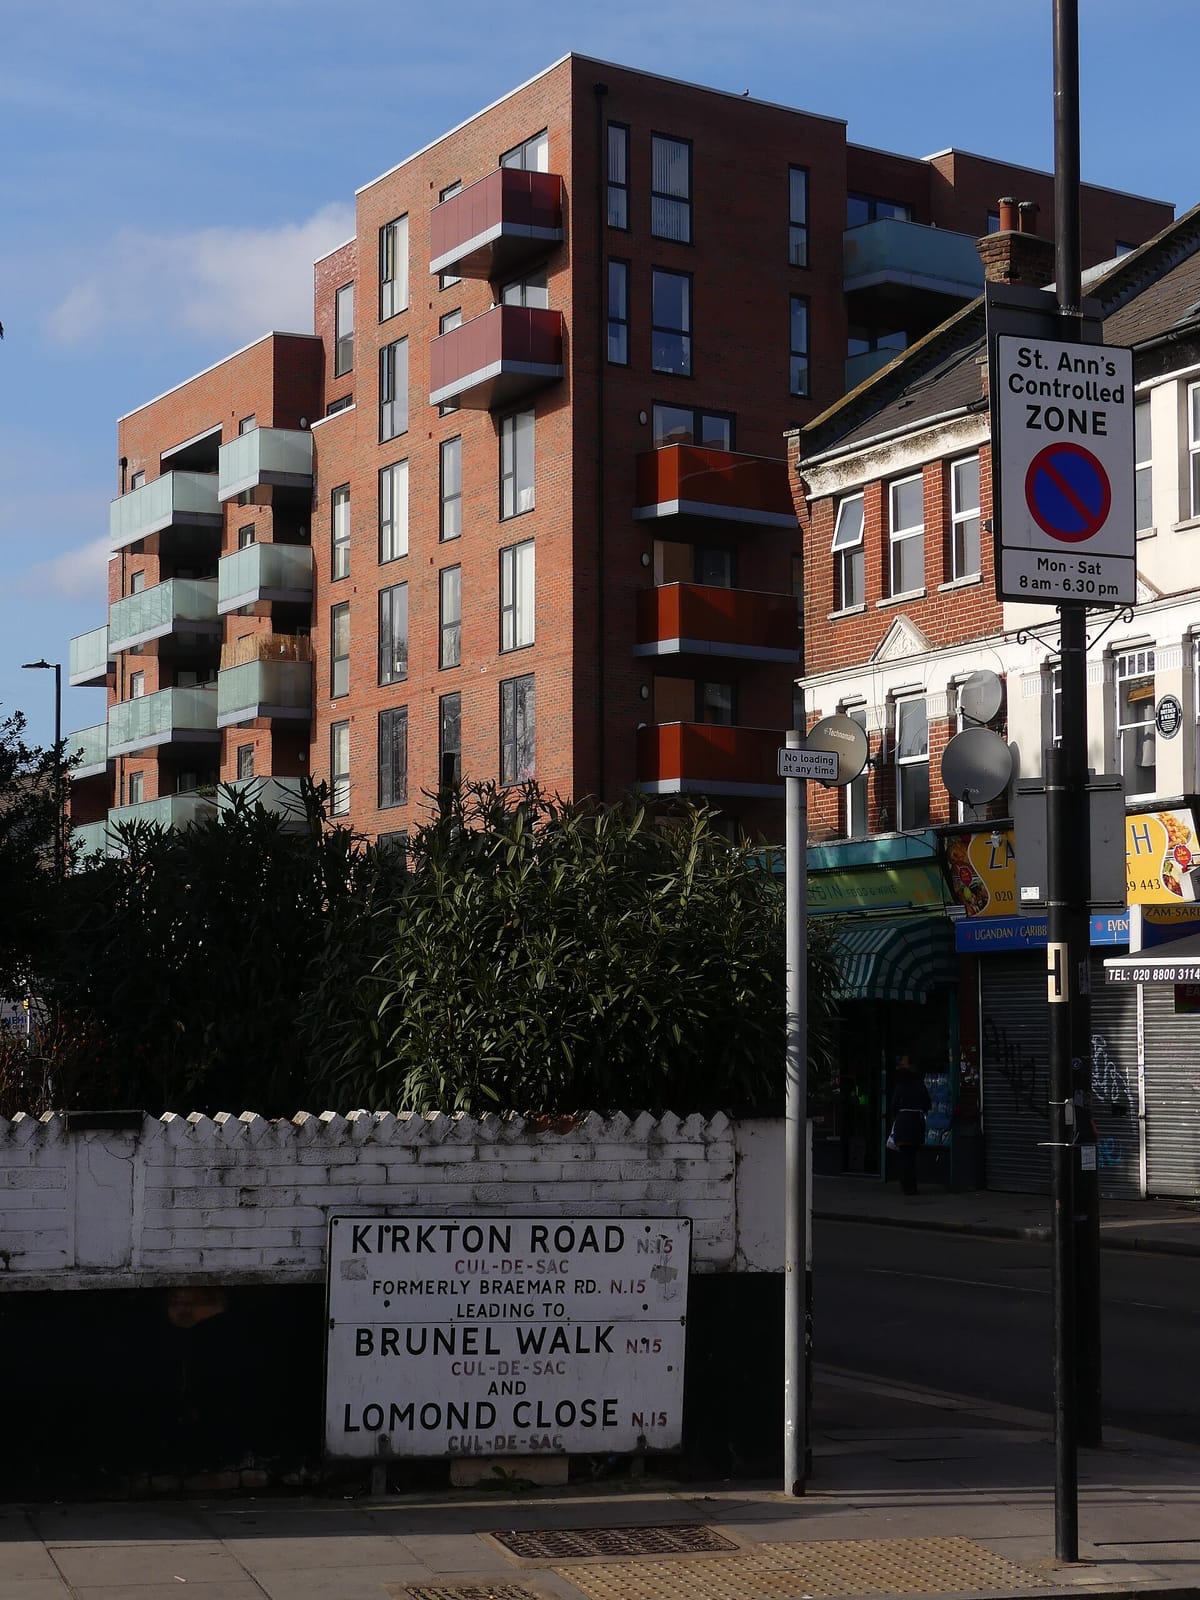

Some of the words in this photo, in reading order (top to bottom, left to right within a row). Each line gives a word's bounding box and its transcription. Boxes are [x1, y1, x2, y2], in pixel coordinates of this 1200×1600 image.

[1017, 347, 1049, 370] St.
[1057, 351, 1116, 377] Ann's
[1008, 373, 1125, 404] Controlled
[1025, 404, 1108, 436] ZONE
[1037, 557, 1066, 573] Mon
[1078, 560, 1102, 576] Sat
[1062, 578, 1094, 594] 6.30
[1098, 584, 1119, 598] pm
[784, 753, 798, 762] No
[800, 754, 834, 766] loading
[783, 765, 793, 773] at
[795, 766, 812, 775] any
[815, 766, 835, 776] time
[995, 890, 1014, 902] 020
[1140, 878, 1161, 891] 443
[974, 926, 1014, 941] UGANDAN
[1108, 969, 1130, 981] TEL:
[1132, 969, 1150, 981] 020
[1152, 968, 1175, 981] 8800
[352, 1225, 511, 1253] KIRKTON
[530, 1225, 625, 1253] ROAD
[636, 1237, 674, 1254] N.15
[454, 1259, 570, 1275] CUL-DE-SAC
[372, 1280, 471, 1296] FORMERLY
[479, 1279, 566, 1295] BRAEMAR
[574, 1279, 602, 1295] RD.
[610, 1279, 646, 1295] N.15
[456, 1303, 535, 1319] LEADING
[542, 1303, 566, 1318] TO
[355, 1326, 501, 1357] BRUNEL
[516, 1325, 615, 1354] WALK
[626, 1338, 662, 1354] N.15
[451, 1360, 566, 1376] CUL-DE-SAC
[487, 1380, 527, 1396] AND
[344, 1402, 497, 1432] LOMOND
[512, 1398, 619, 1428] CLOSE
[631, 1412, 667, 1428] N.15
[447, 1434, 563, 1450] CUL-DE-SAC
